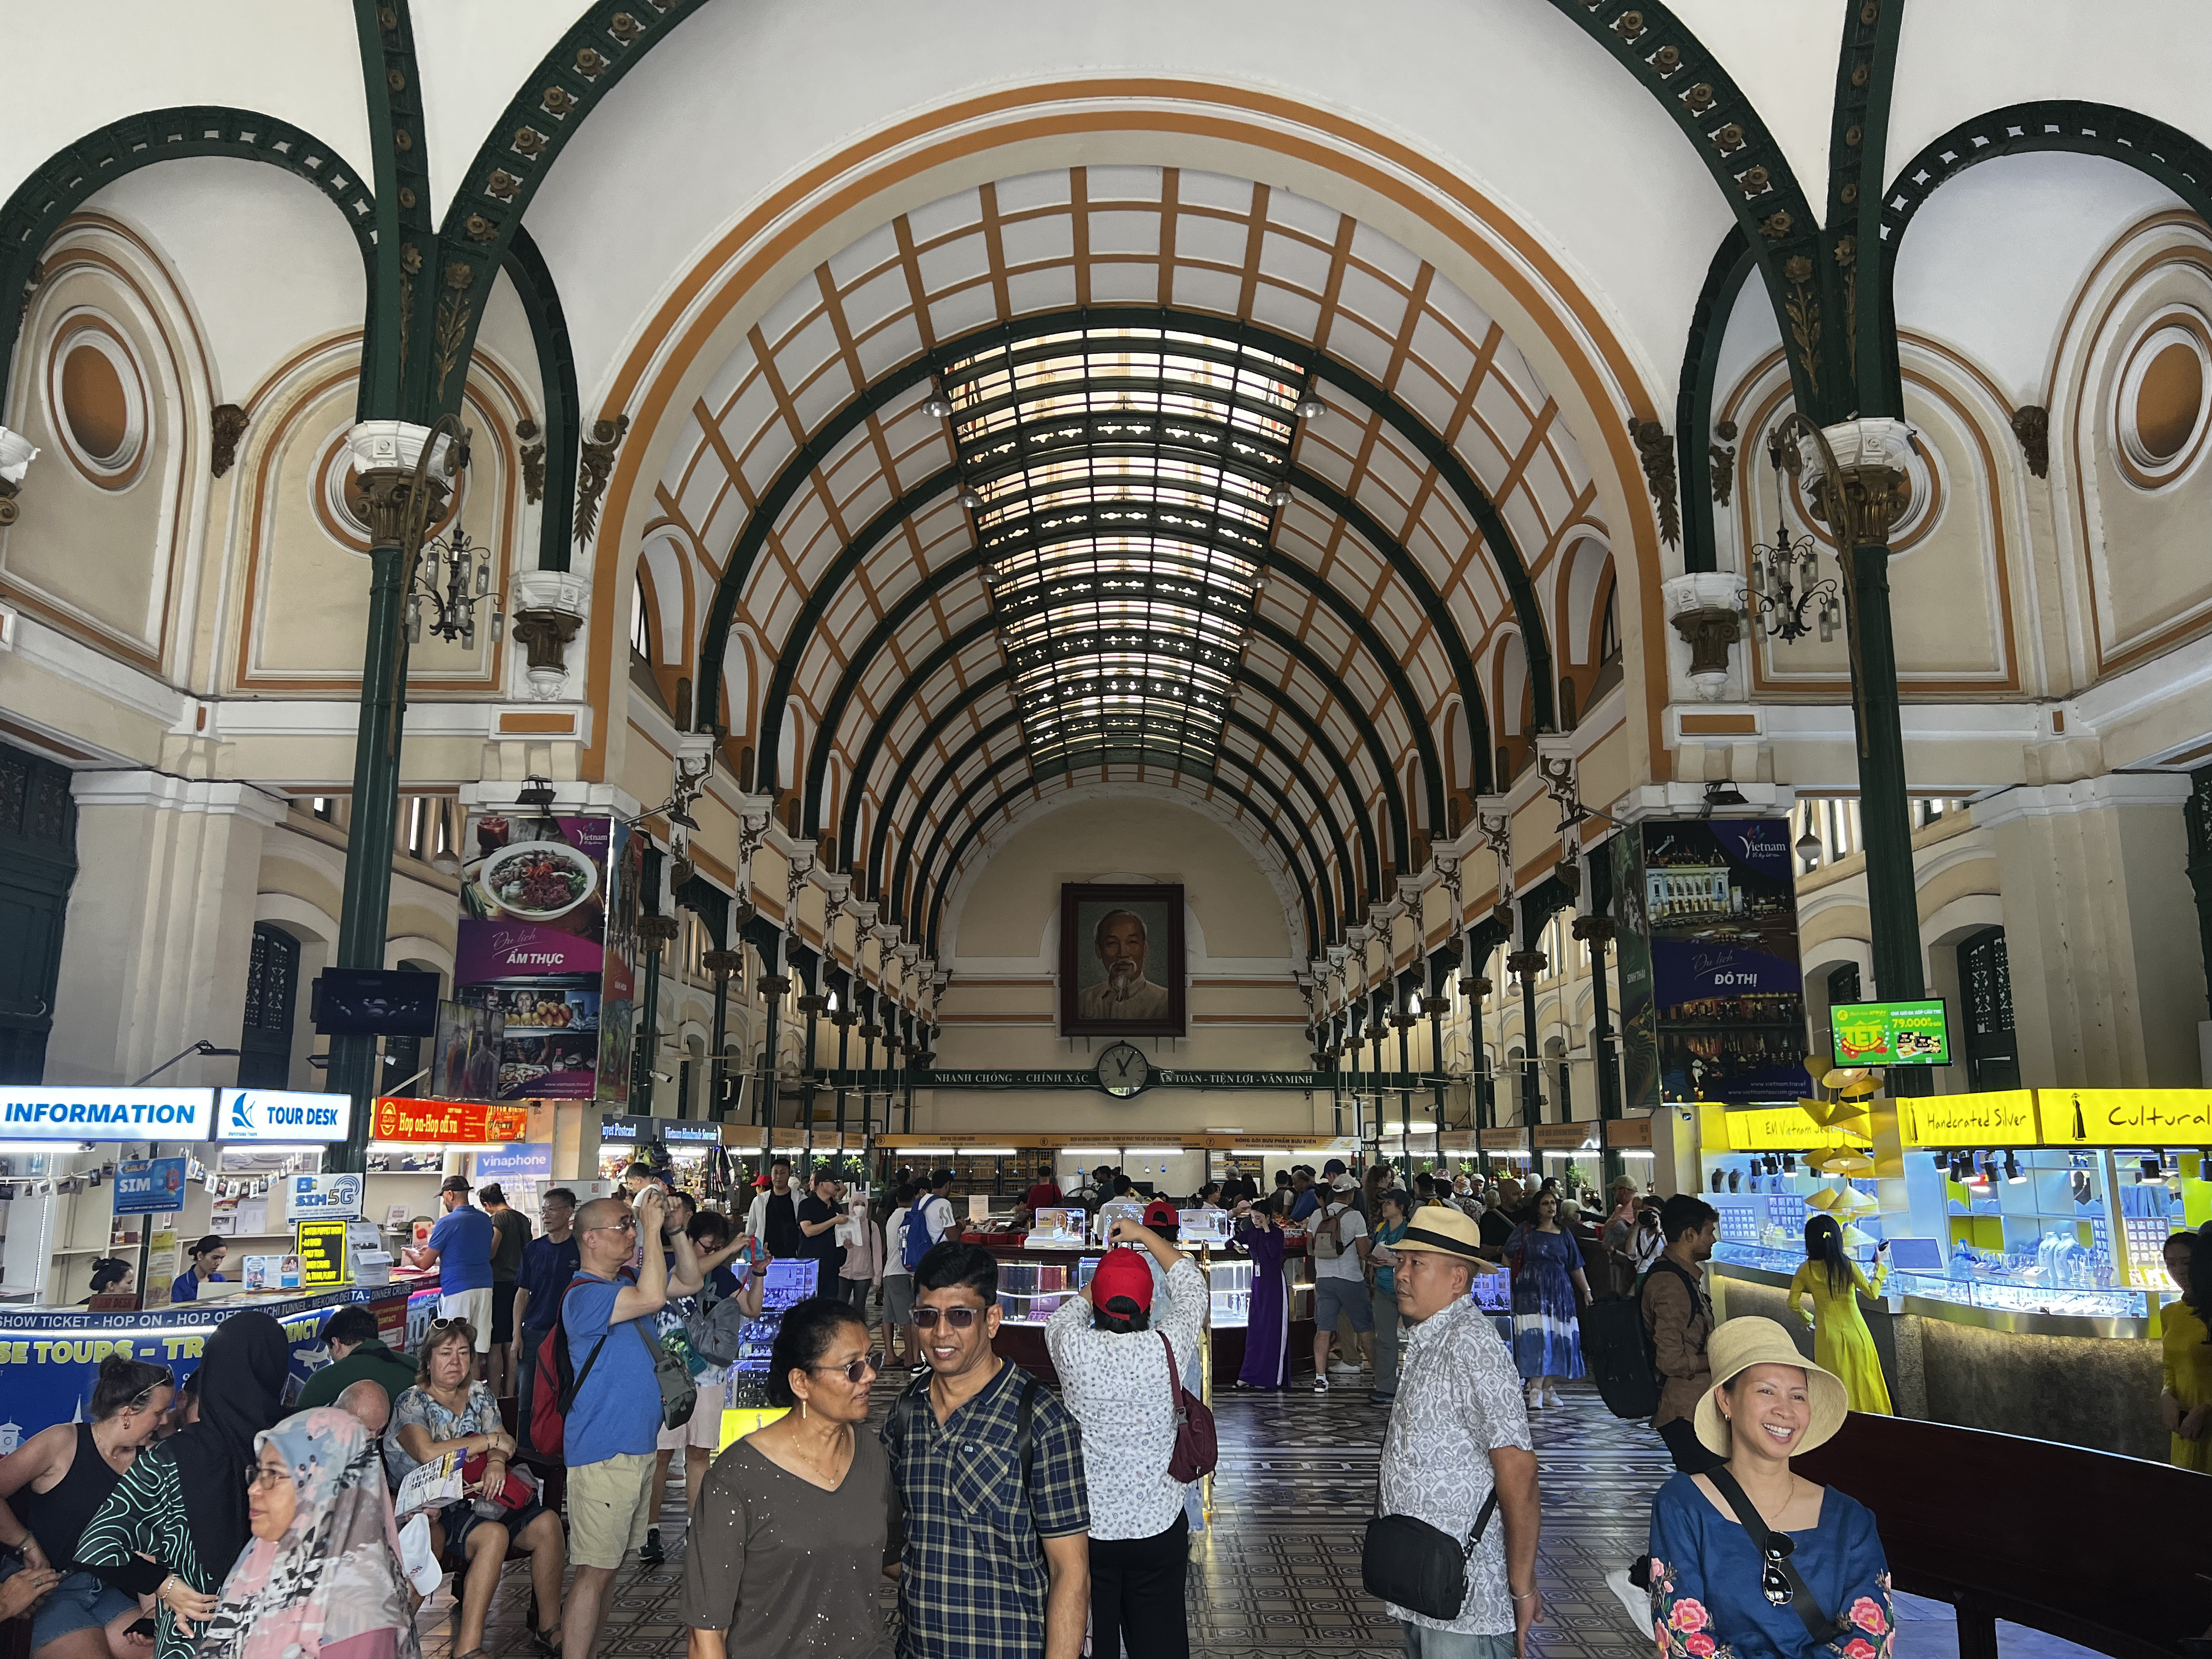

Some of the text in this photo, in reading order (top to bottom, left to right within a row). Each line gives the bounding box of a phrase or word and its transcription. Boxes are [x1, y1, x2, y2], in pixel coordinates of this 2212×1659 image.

[576, 830, 607, 845] Vietnam
[1738, 836, 1786, 859] Vietnam
[492, 928, 536, 951] Du lịch
[506, 948, 564, 966] ẨM THỰC
[1692, 950, 1733, 971] Du lịch
[1714, 971, 1757, 987] ĐÔ THỊ
[1840, 1019, 1882, 1046] TẾT
[935, 1072, 1089, 1083] NHANH CHÓNG CHÍNH XÁC
[1175, 1072, 1202, 1083] TOÀN
[1209, 1073, 1234, 1084] TIỆN
[1237, 1073, 1254, 1085] LỢI
[1261, 1072, 1282, 1083] VĂN
[1285, 1075, 1313, 1084] MINH
[4, 1103, 195, 1123] INFORMATION
[267, 1107, 338, 1125] TOUR DESK
[1927, 1106, 2027, 1129] Handcrated Silver
[2107, 1104, 2210, 1126] Cultural
[399, 1112, 413, 1137] Hop
[415, 1114, 439, 1138] on-Hop
[440, 1115, 457, 1134] off.vn
[614, 1123, 637, 1137] Postcard
[665, 1126, 681, 1139] Vietnam
[1766, 1121, 1811, 1135] EM Vietnam
[124, 1163, 145, 1173] SALE
[483, 1155, 546, 1167] vinaphone
[119, 1178, 150, 1193] SIM
[295, 1188, 354, 1207] SIM 5G
[0, 1316, 37, 1327] SHOW
[40, 1316, 90, 1328] TICKET
[102, 1316, 135, 1327] HOP
[139, 1314, 161, 1327] ON
[177, 1312, 211, 1324] HOP
[282, 1301, 306, 1316] TUNNEL
[312, 1295, 338, 1308] MEKONG
[340, 1290, 363, 1303] DELTA
[371, 1288, 392, 1301] DINNER
[392, 1285, 412, 1297] CRUISE
[113, 1297, 133, 1308] DESK
[33, 1339, 134, 1364] TOURS
[281, 1316, 321, 1344] ENCY
